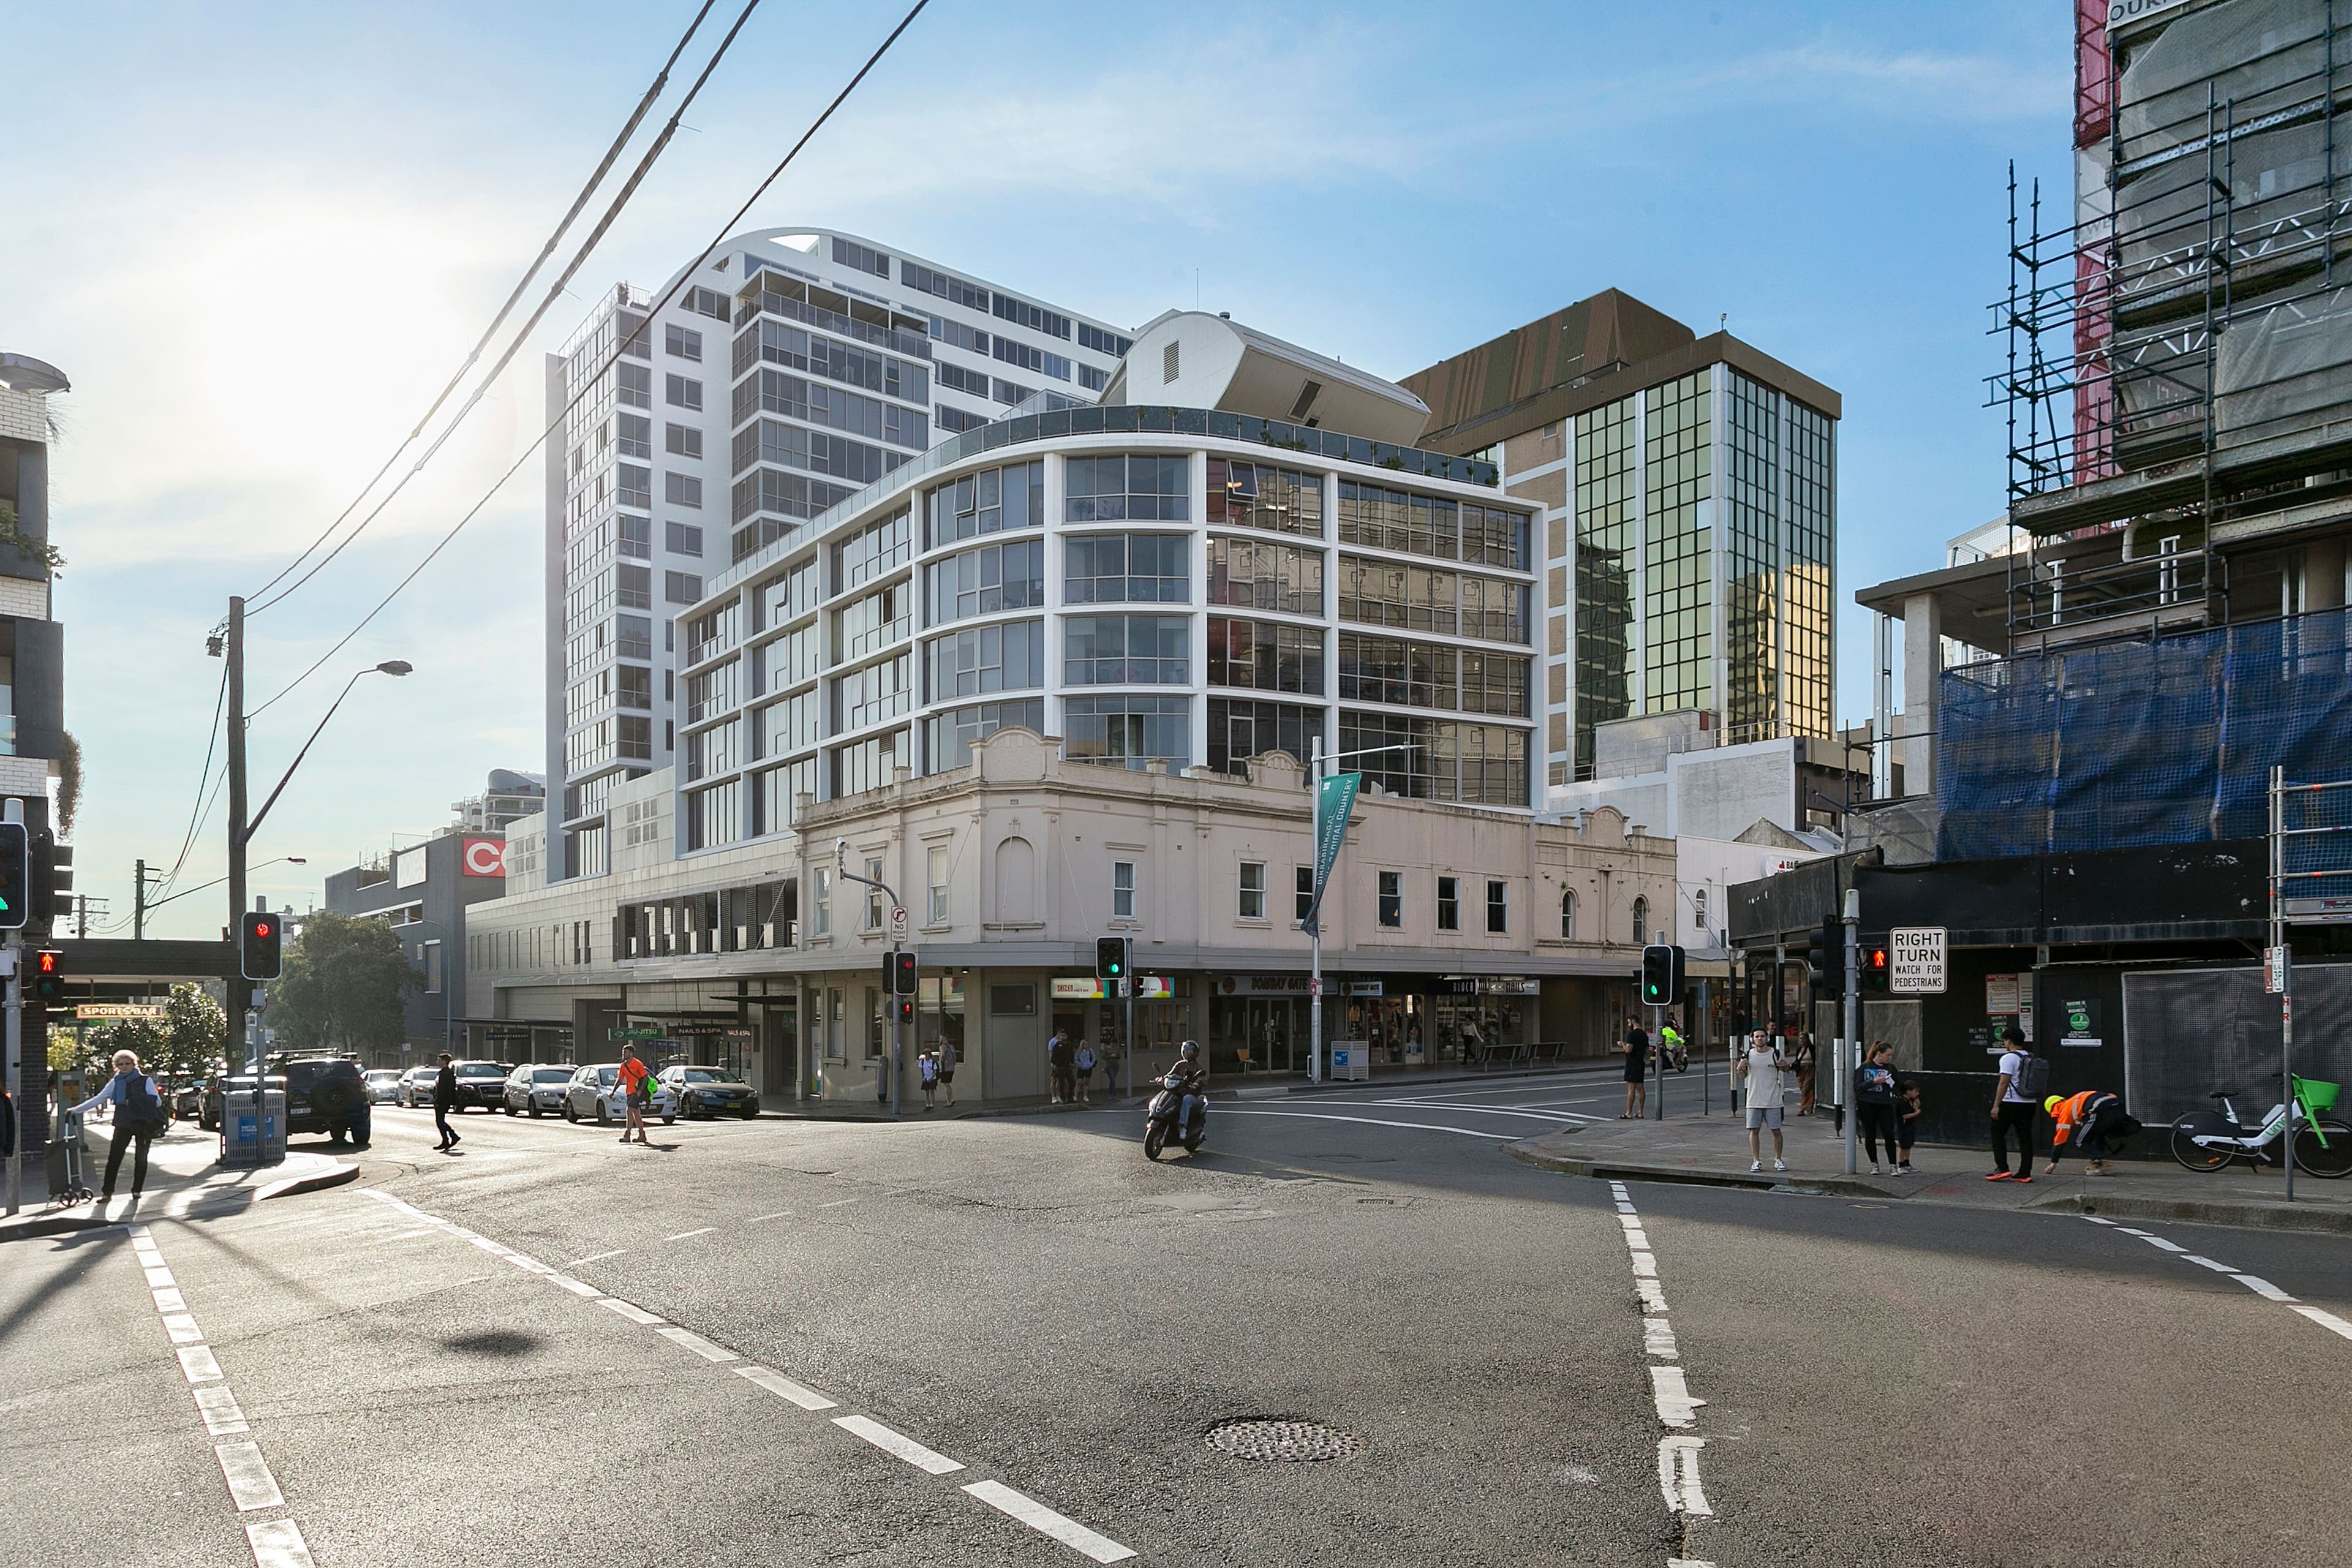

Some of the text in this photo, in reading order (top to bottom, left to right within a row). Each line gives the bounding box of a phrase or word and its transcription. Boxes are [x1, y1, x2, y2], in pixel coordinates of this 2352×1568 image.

[2110, 0, 2166, 21] OUR
[1895, 933, 1942, 946] RIGHT
[1898, 949, 1940, 962] TURN
[1895, 965, 1942, 974] WATCH FOR
[1506, 982, 1525, 993] NAILS
[1894, 978, 1942, 987] PEDESTRIANS
